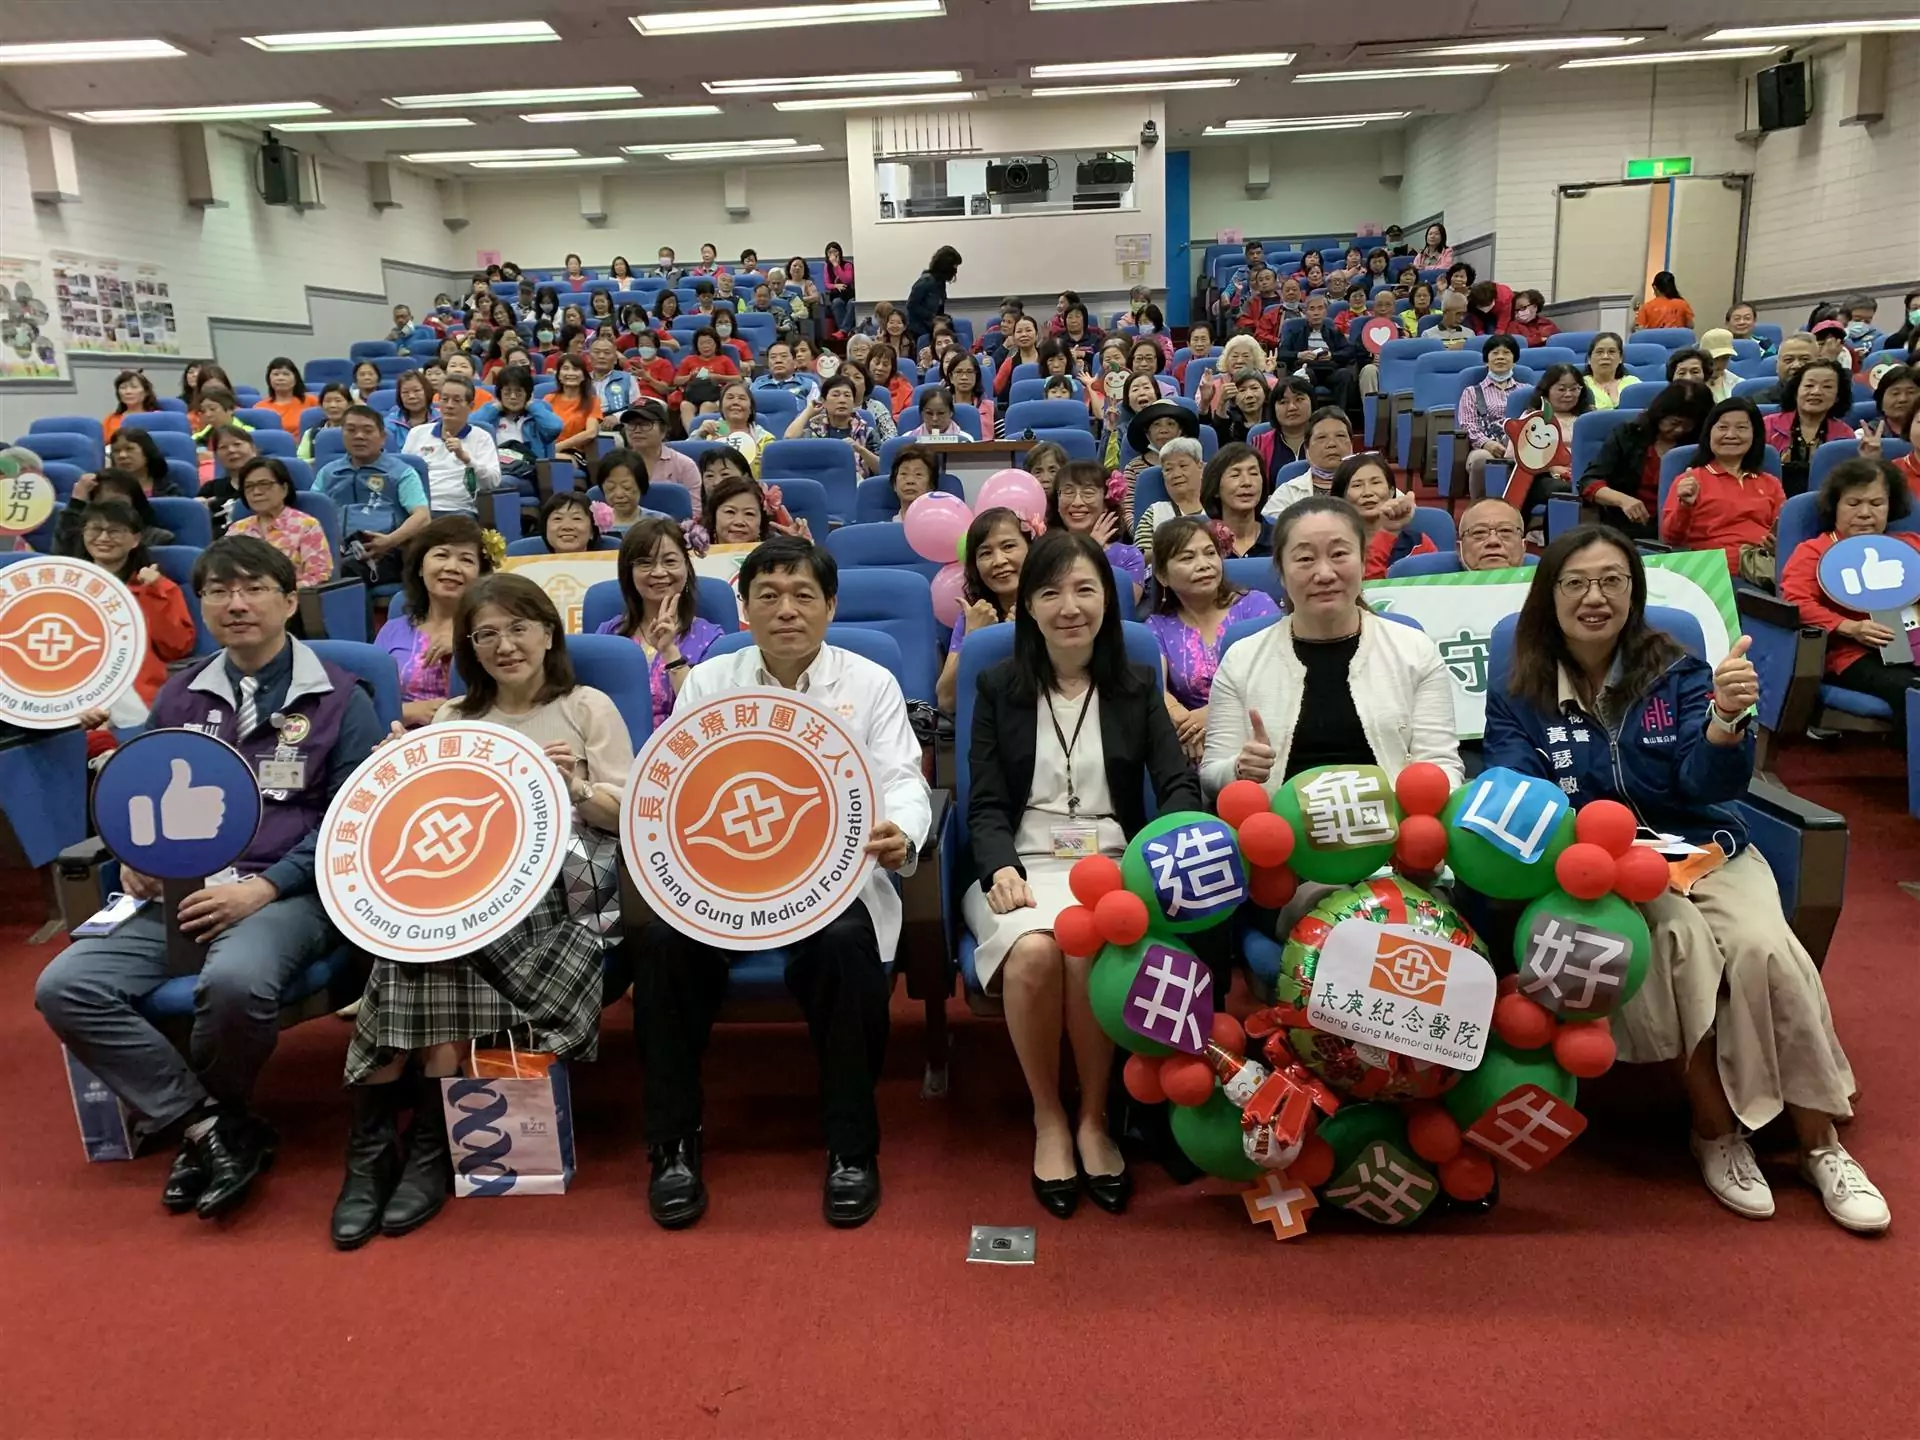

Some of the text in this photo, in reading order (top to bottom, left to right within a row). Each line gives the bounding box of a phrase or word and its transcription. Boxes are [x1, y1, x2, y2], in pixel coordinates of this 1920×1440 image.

[6, 480, 35, 522] 活力
[21, 700, 74, 713] Medical
[77, 647, 127, 706] Foundation
[639, 702, 849, 823] 長庚醫療財團法人
[1546, 726, 1579, 794] 黃瑟敏
[332, 735, 520, 876] 長庚醫療財團法人
[1301, 770, 1395, 844] 龜
[1462, 780, 1559, 857] 山
[353, 779, 549, 941] Chang Gung Medical Foundation
[650, 787, 862, 930] Chang Gung Medical Foundation
[1147, 827, 1243, 917] 造
[1133, 955, 1211, 1050] 共
[1522, 919, 1625, 1009] 好
[1311, 1010, 1477, 1063] Chang Gung Memorial Hospital
[1318, 982, 1481, 1049] 長庚紀念醫院
[1465, 1091, 1572, 1171] 生
[1326, 1146, 1433, 1224] 活
